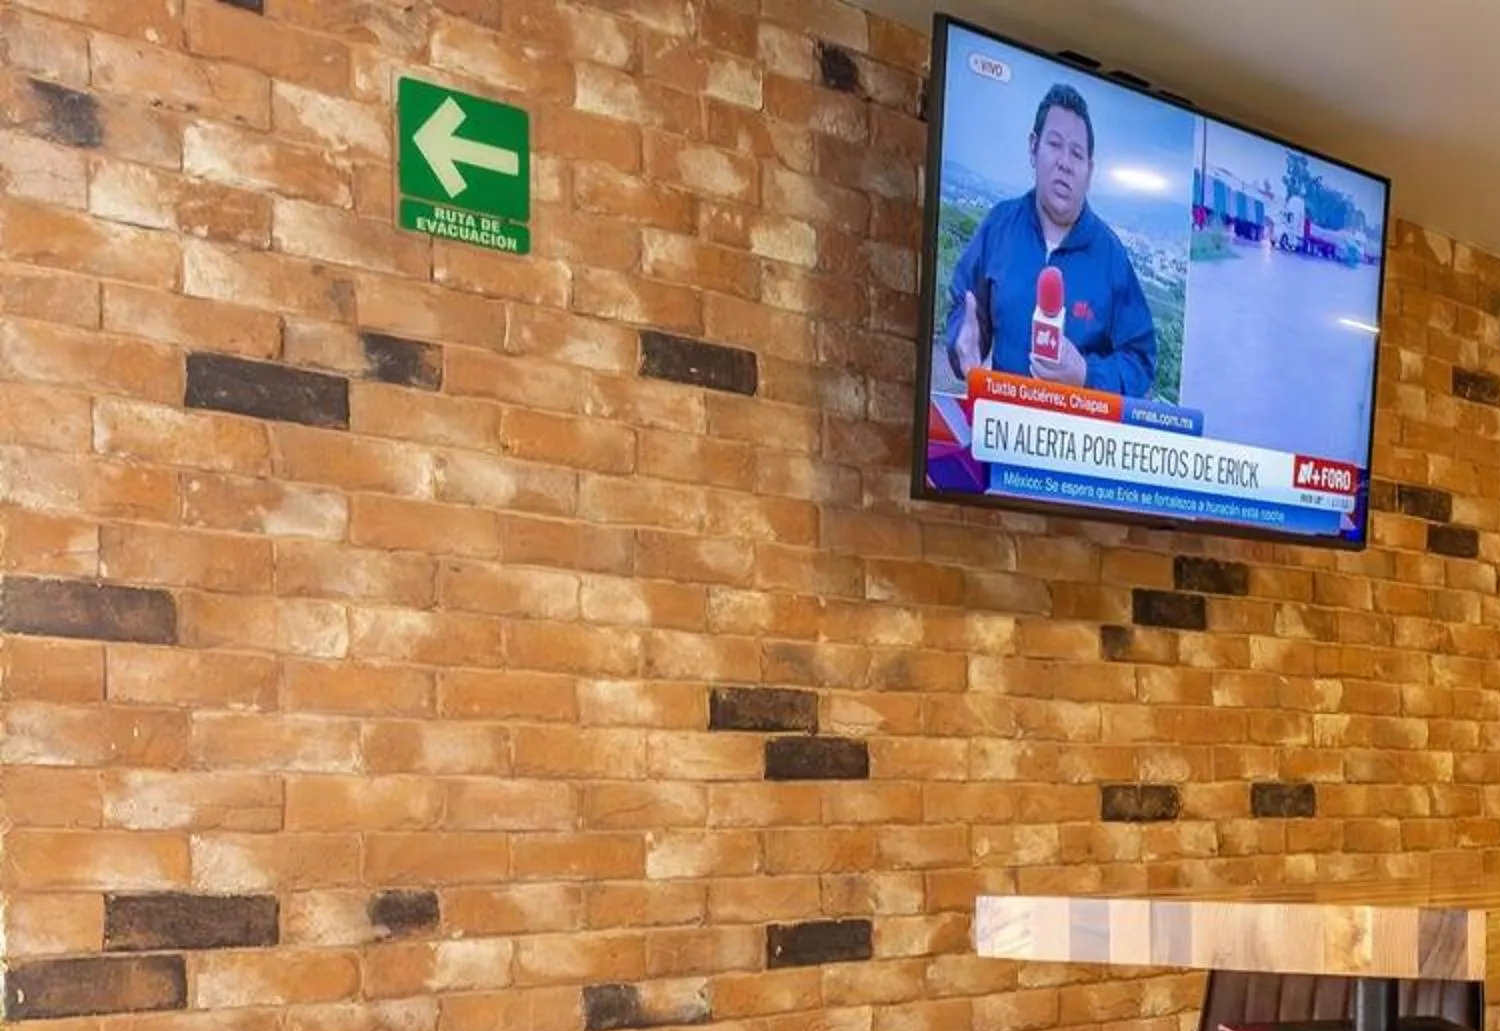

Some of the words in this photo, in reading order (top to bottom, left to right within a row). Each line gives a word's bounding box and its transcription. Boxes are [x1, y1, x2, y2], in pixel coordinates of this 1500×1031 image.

[416, 216, 518, 251] EVACUACION
[434, 207, 476, 227] RUTA
[480, 218, 500, 234] DE
[986, 377, 1017, 398] Tuxtla
[1070, 393, 1110, 415] Chiapas
[984, 417, 1009, 450] EN
[1014, 422, 1077, 462] ALERTA
[1082, 433, 1117, 468] POR
[1121, 441, 1189, 479] EFECTOS
[1193, 453, 1214, 482] DE
[1217, 456, 1259, 489] ERICK
[1045, 476, 1059, 493] Se
[1061, 481, 1094, 498] espera
